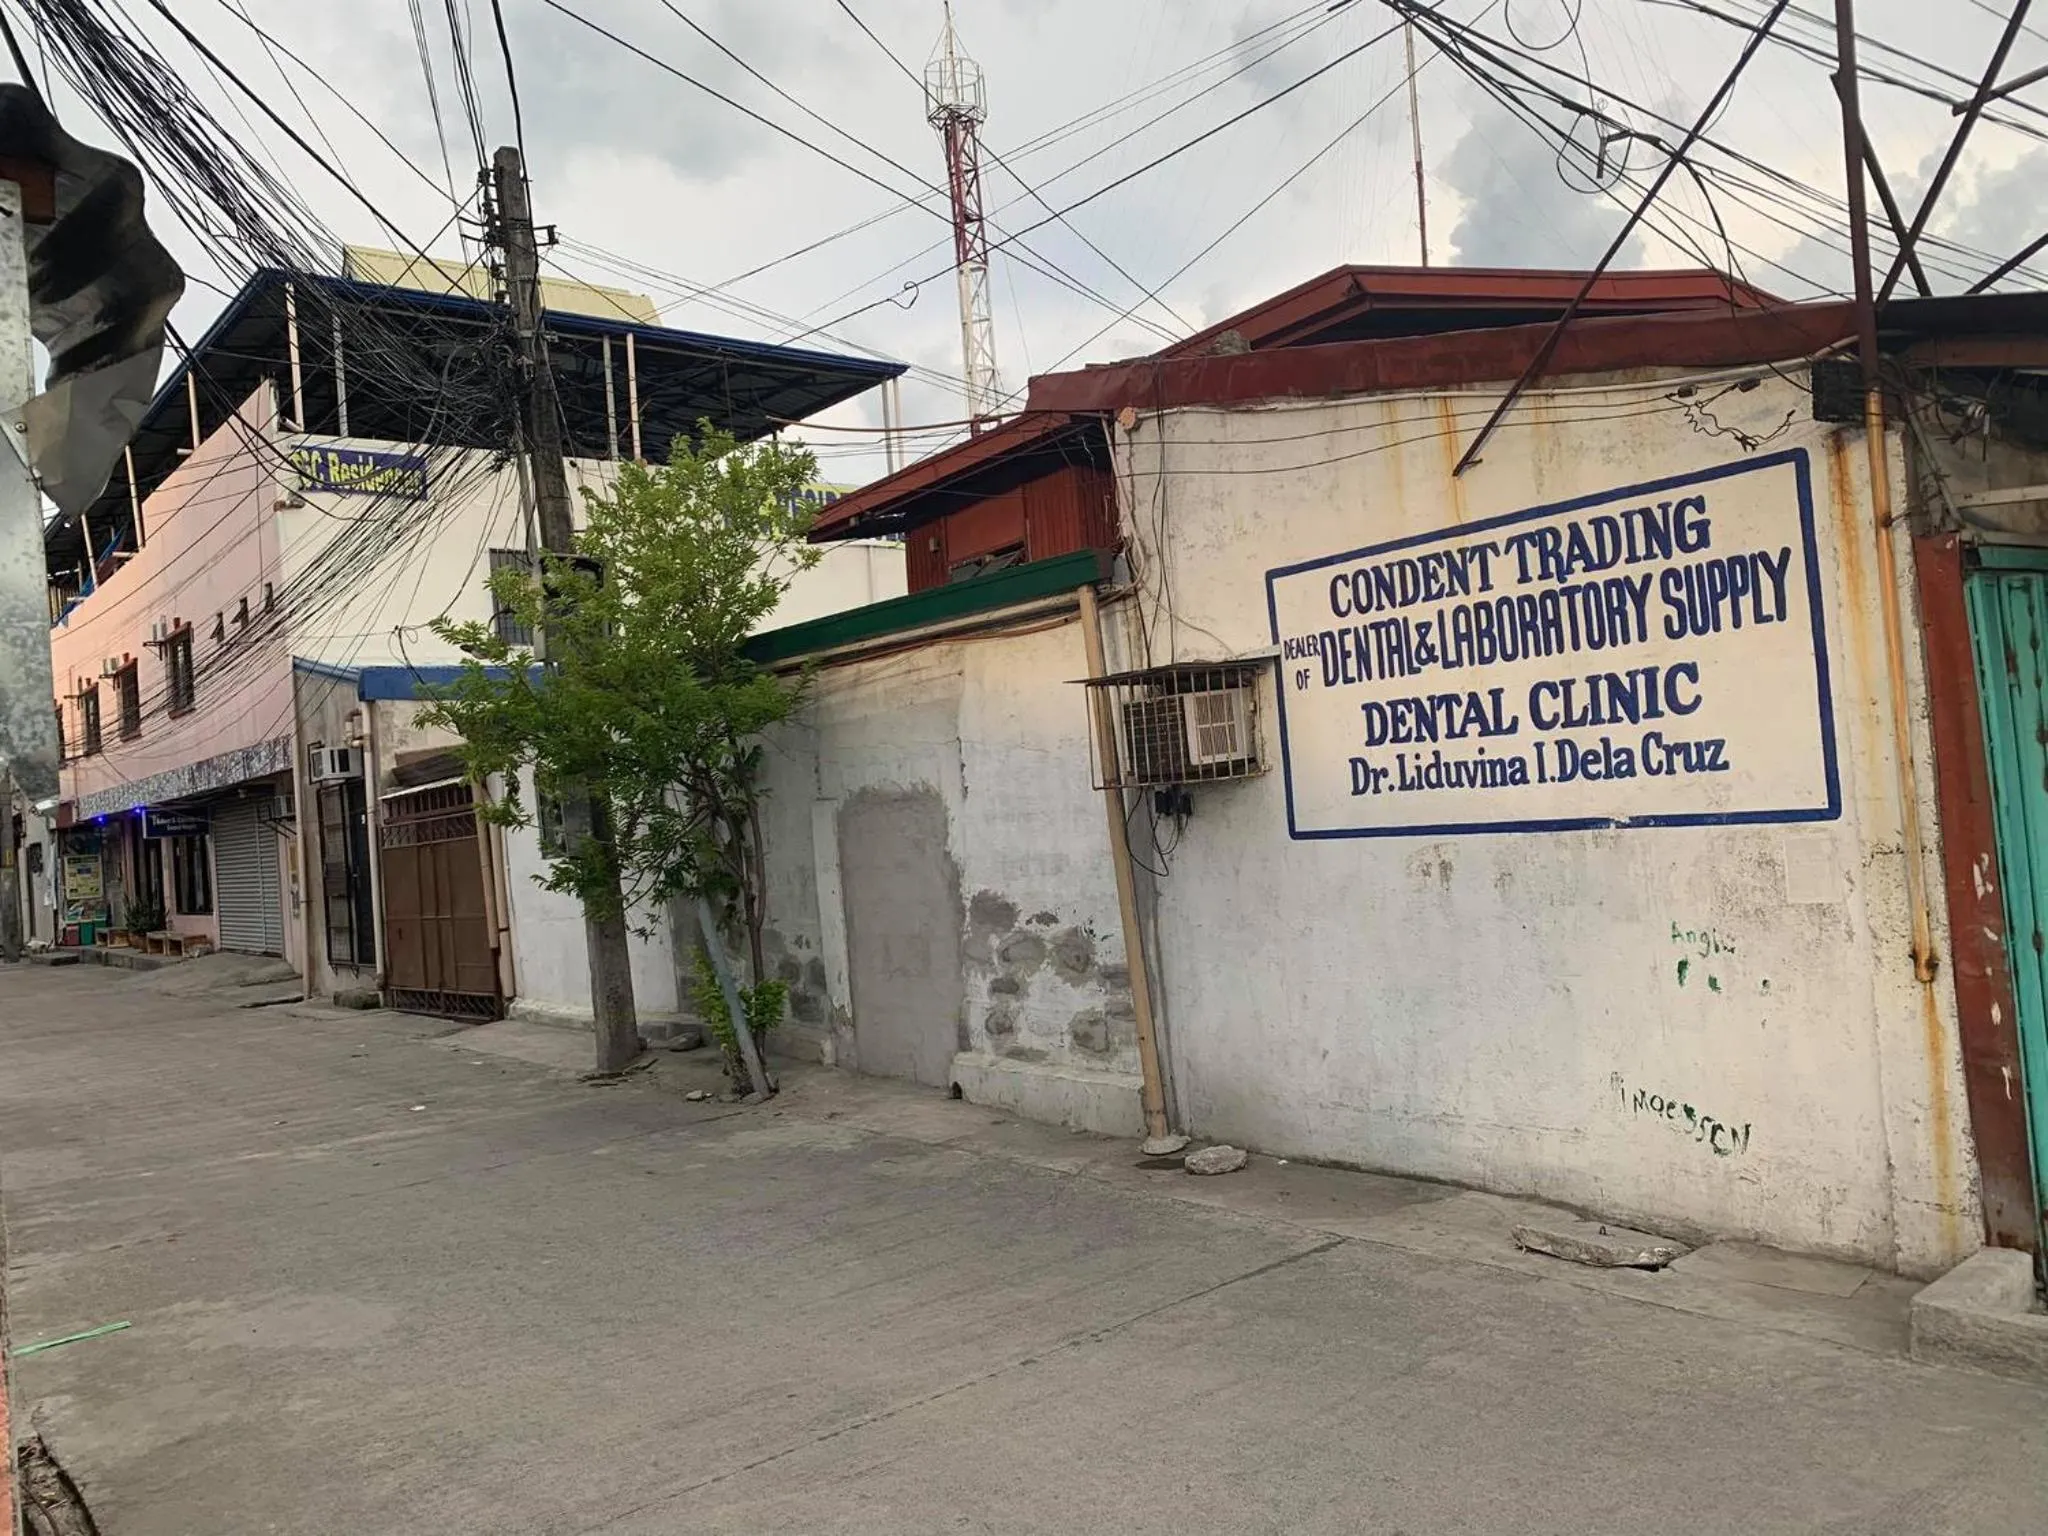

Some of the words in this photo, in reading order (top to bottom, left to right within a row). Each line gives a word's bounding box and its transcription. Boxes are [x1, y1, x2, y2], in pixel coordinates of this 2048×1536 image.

[1329, 541, 1502, 618] CONDENT
[1503, 494, 1712, 585] TRADING
[1283, 634, 1321, 661] DEALER
[1318, 616, 1422, 688] DENTAL
[1660, 546, 1792, 640] SUPPLY
[1295, 668, 1311, 691] OF
[1361, 687, 1519, 748] DENTAL
[1528, 661, 1703, 731] CLINIC
[1641, 731, 1730, 778] Cruz
